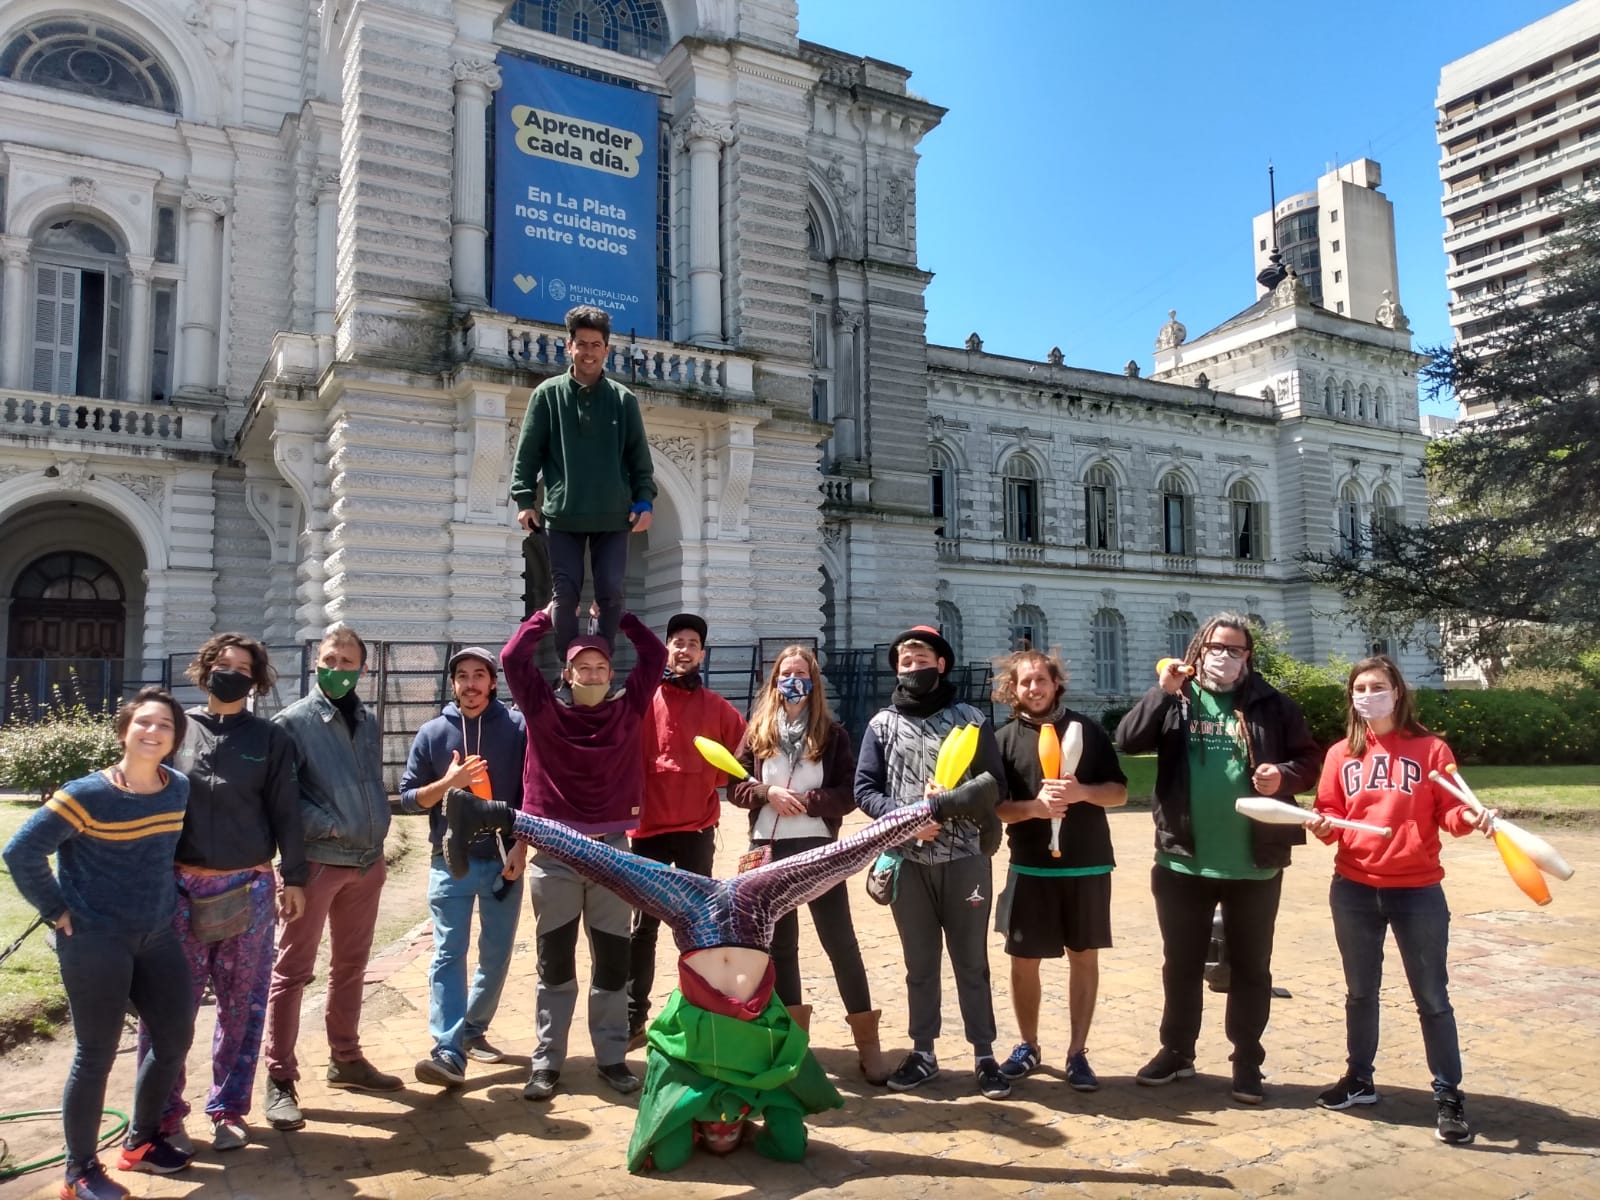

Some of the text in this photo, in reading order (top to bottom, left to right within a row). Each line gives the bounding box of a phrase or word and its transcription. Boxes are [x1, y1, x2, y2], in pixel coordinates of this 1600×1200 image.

[524, 110, 633, 150] Aprender
[527, 136, 630, 172] cada día.
[528, 186, 626, 221] En La Plata
[515, 204, 637, 240] nos cuidamos
[525, 225, 628, 256] entre todos
[569, 283, 639, 303] MUNICIPALIDAD
[569, 294, 626, 311] DE LA PLATA
[1190, 719, 1237, 737] VINTA
[1342, 753, 1422, 798] GAP
